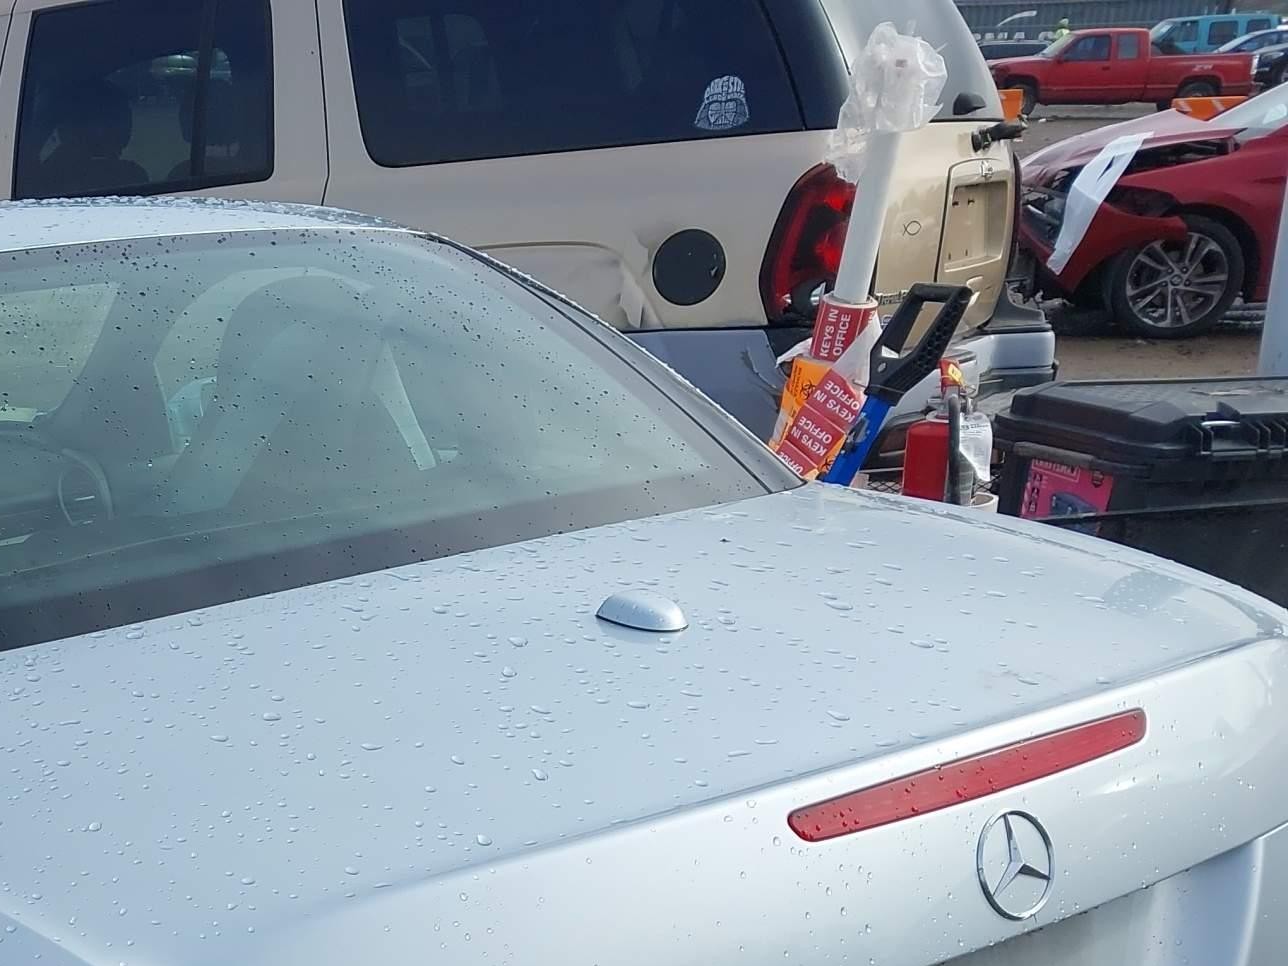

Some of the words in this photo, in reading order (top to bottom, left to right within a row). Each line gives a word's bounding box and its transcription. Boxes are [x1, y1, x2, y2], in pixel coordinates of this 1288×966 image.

[819, 327, 834, 357] KEYS
[829, 308, 839, 320] IN
[832, 313, 851, 356] OFFICE
[813, 389, 828, 401] IN
[824, 380, 860, 411] OFFICE
[826, 398, 855, 423] KEYS
[791, 425, 805, 438] IN
[798, 415, 833, 443] OFFICE
[801, 434, 827, 456] KEYS
